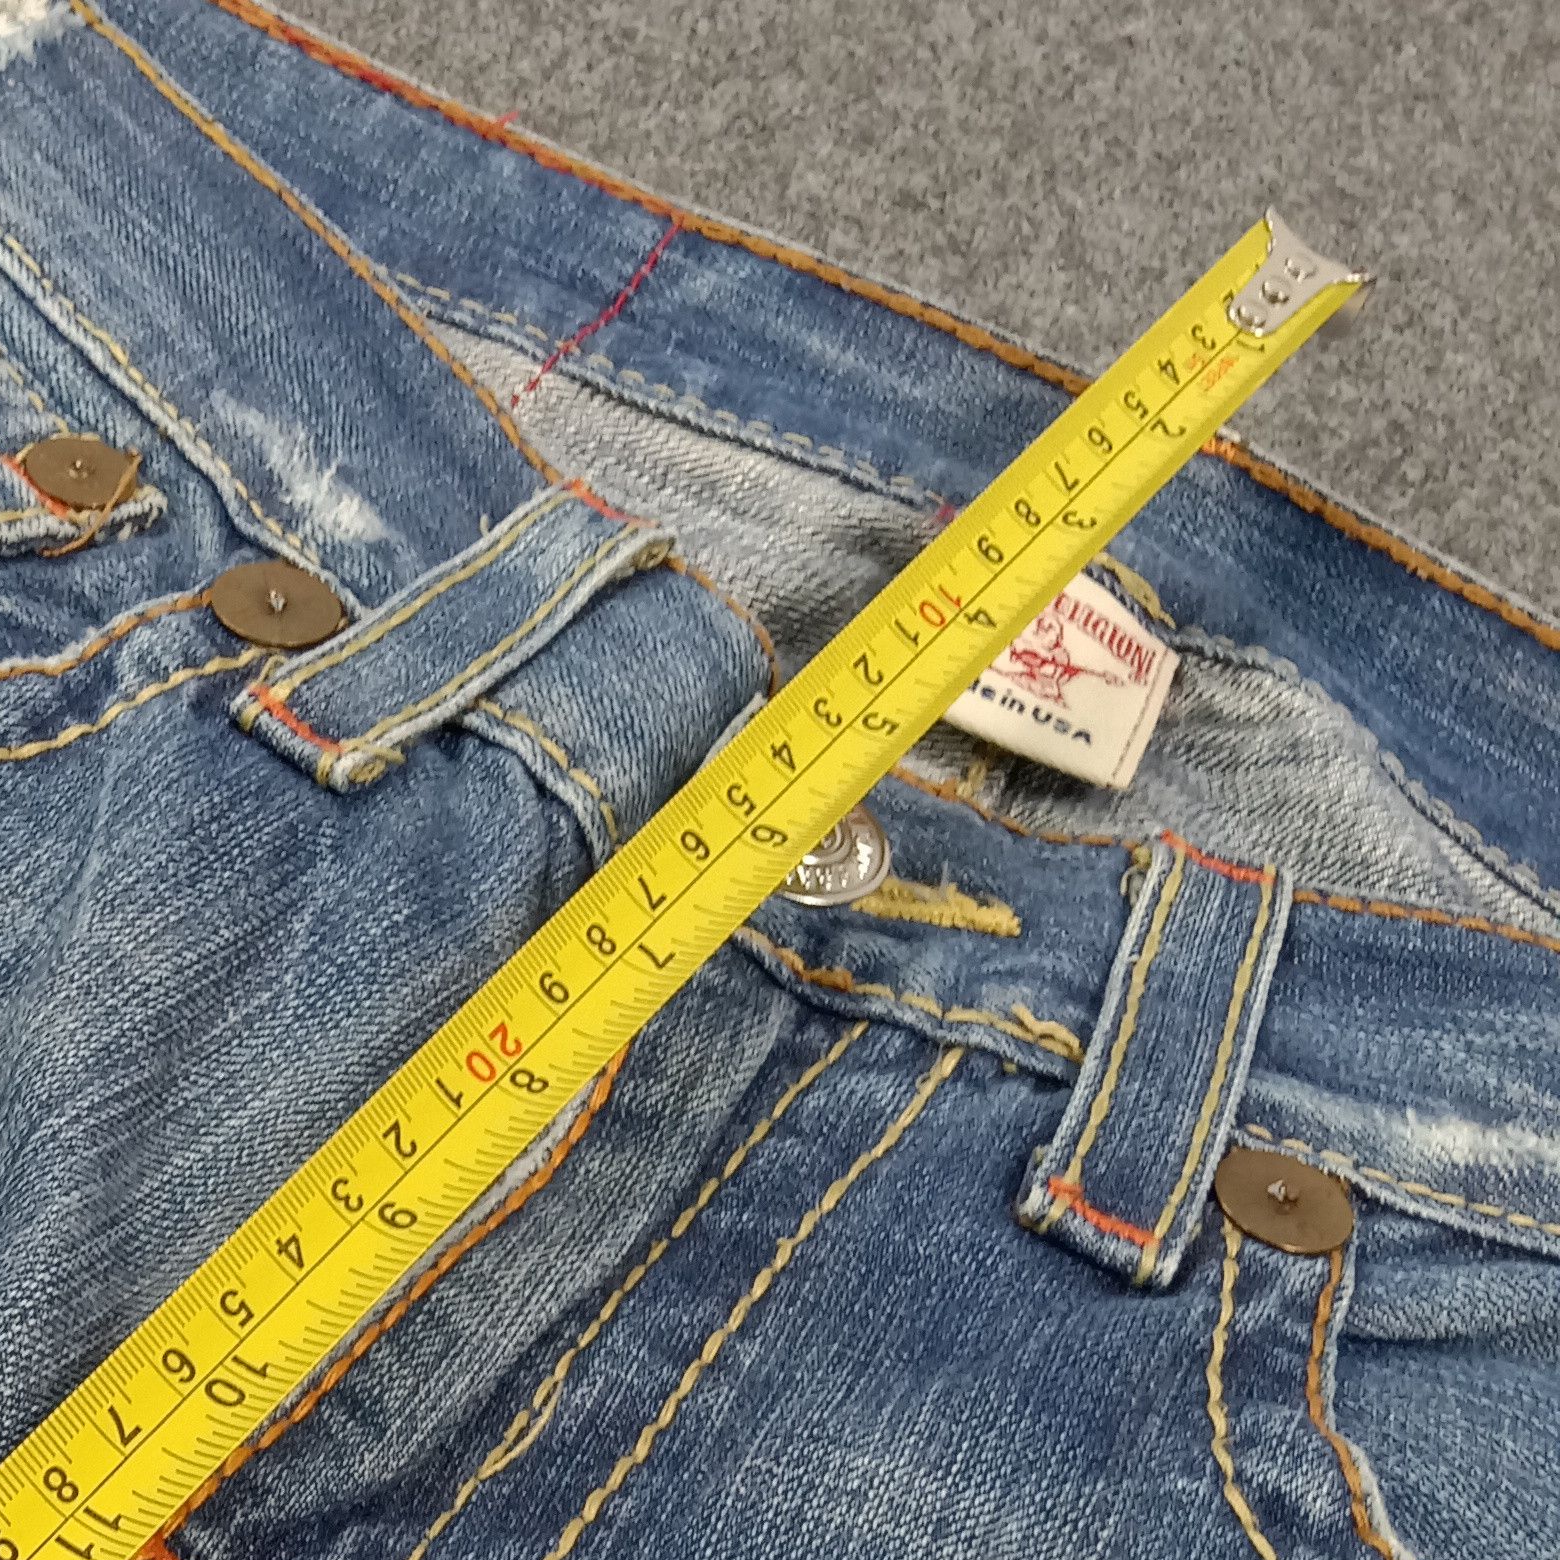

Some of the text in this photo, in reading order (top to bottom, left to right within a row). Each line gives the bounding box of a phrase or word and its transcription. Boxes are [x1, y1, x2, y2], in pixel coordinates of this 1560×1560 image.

[1191, 324, 1216, 350] 3
[1158, 358, 1180, 386] 4
[1123, 390, 1149, 422] 5
[1087, 424, 1114, 457] 6
[1151, 418, 1187, 440] 2
[1052, 460, 1081, 494] 7
[1014, 497, 1042, 529] 8
[1062, 509, 1098, 531] 3
[976, 535, 1004, 566] 9
[918, 584, 962, 629] 10
[963, 606, 997, 630] 4
[894, 618, 920, 647] 1
[852, 652, 885, 687] 2
[813, 697, 842, 729] 3
[862, 711, 900, 738] 5
[998, 688, 1026, 715] in
[1031, 707, 1092, 745] USA
[770, 739, 797, 773] 4
[725, 783, 757, 817] 5
[680, 828, 711, 861] 6
[750, 823, 789, 848] 6
[637, 874, 667, 912] 7
[585, 922, 617, 957] 8
[637, 941, 676, 970] 7
[539, 971, 570, 1005] 9
[465, 1021, 523, 1083] 20
[435, 1077, 464, 1111] 1
[509, 1068, 550, 1094] 8
[382, 1118, 418, 1159] 2
[330, 1176, 364, 1213] 3
[377, 1200, 419, 1230] 9
[275, 1232, 306, 1271] 4
[219, 1289, 255, 1328] 5
[161, 1348, 196, 1384] 6
[204, 1354, 272, 1408] 10
[108, 1404, 143, 1447] 7
[42, 1465, 79, 1504] 8
[54, 1505, 122, 1560] 11
